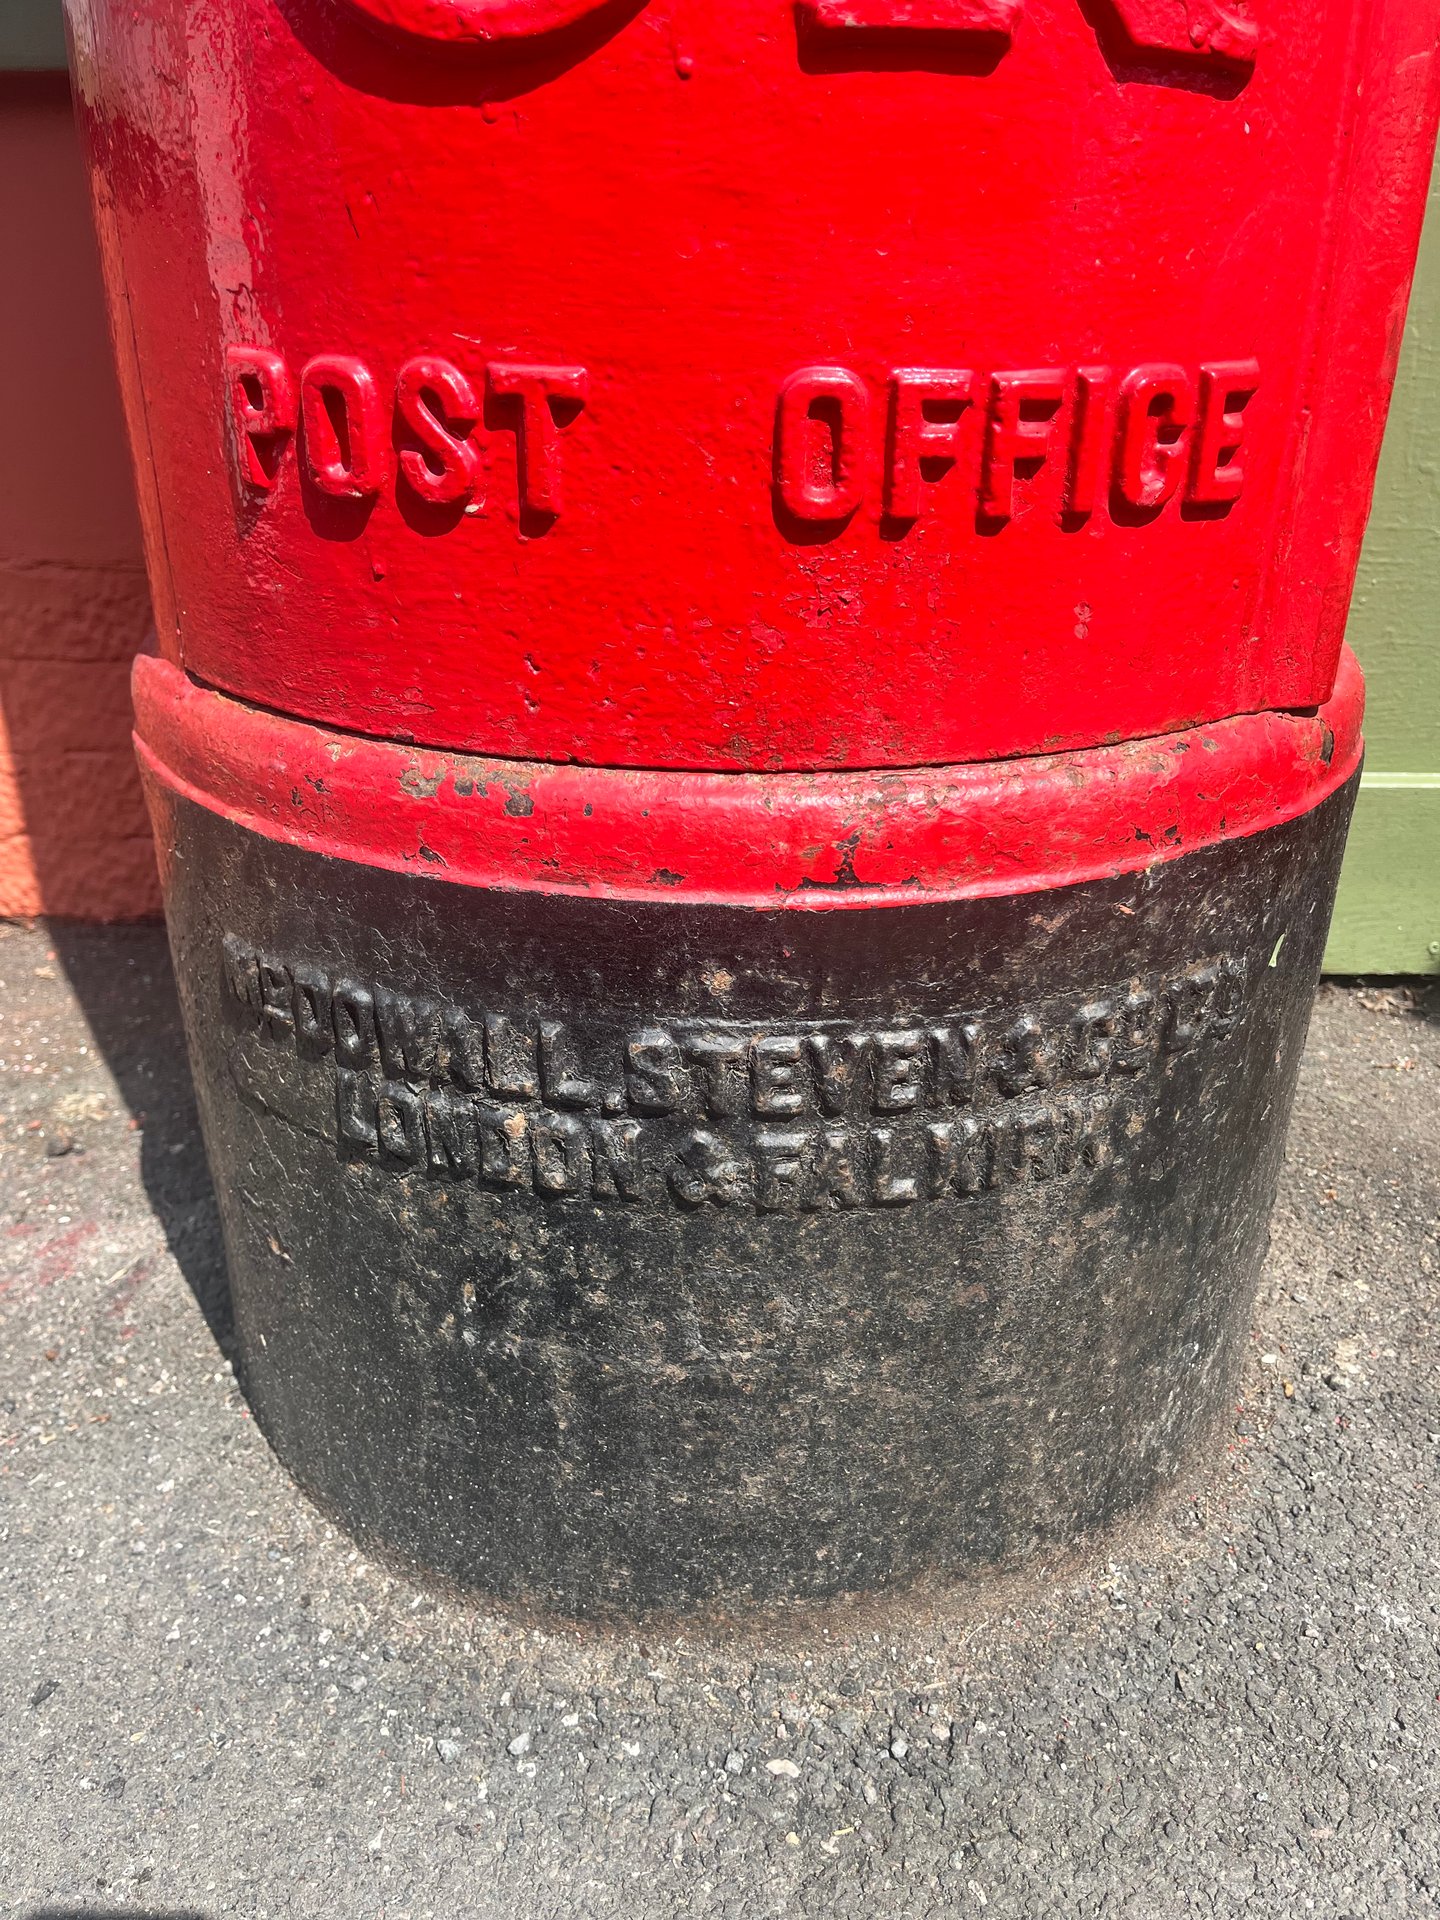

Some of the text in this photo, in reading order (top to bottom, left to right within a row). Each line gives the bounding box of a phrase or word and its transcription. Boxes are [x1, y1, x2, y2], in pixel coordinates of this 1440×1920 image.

[225, 345, 1260, 532] POST OFFICE
[626, 1020, 985, 1114] STEVEN
[338, 1068, 642, 1200] LONDON
[670, 1128, 754, 1206] &
